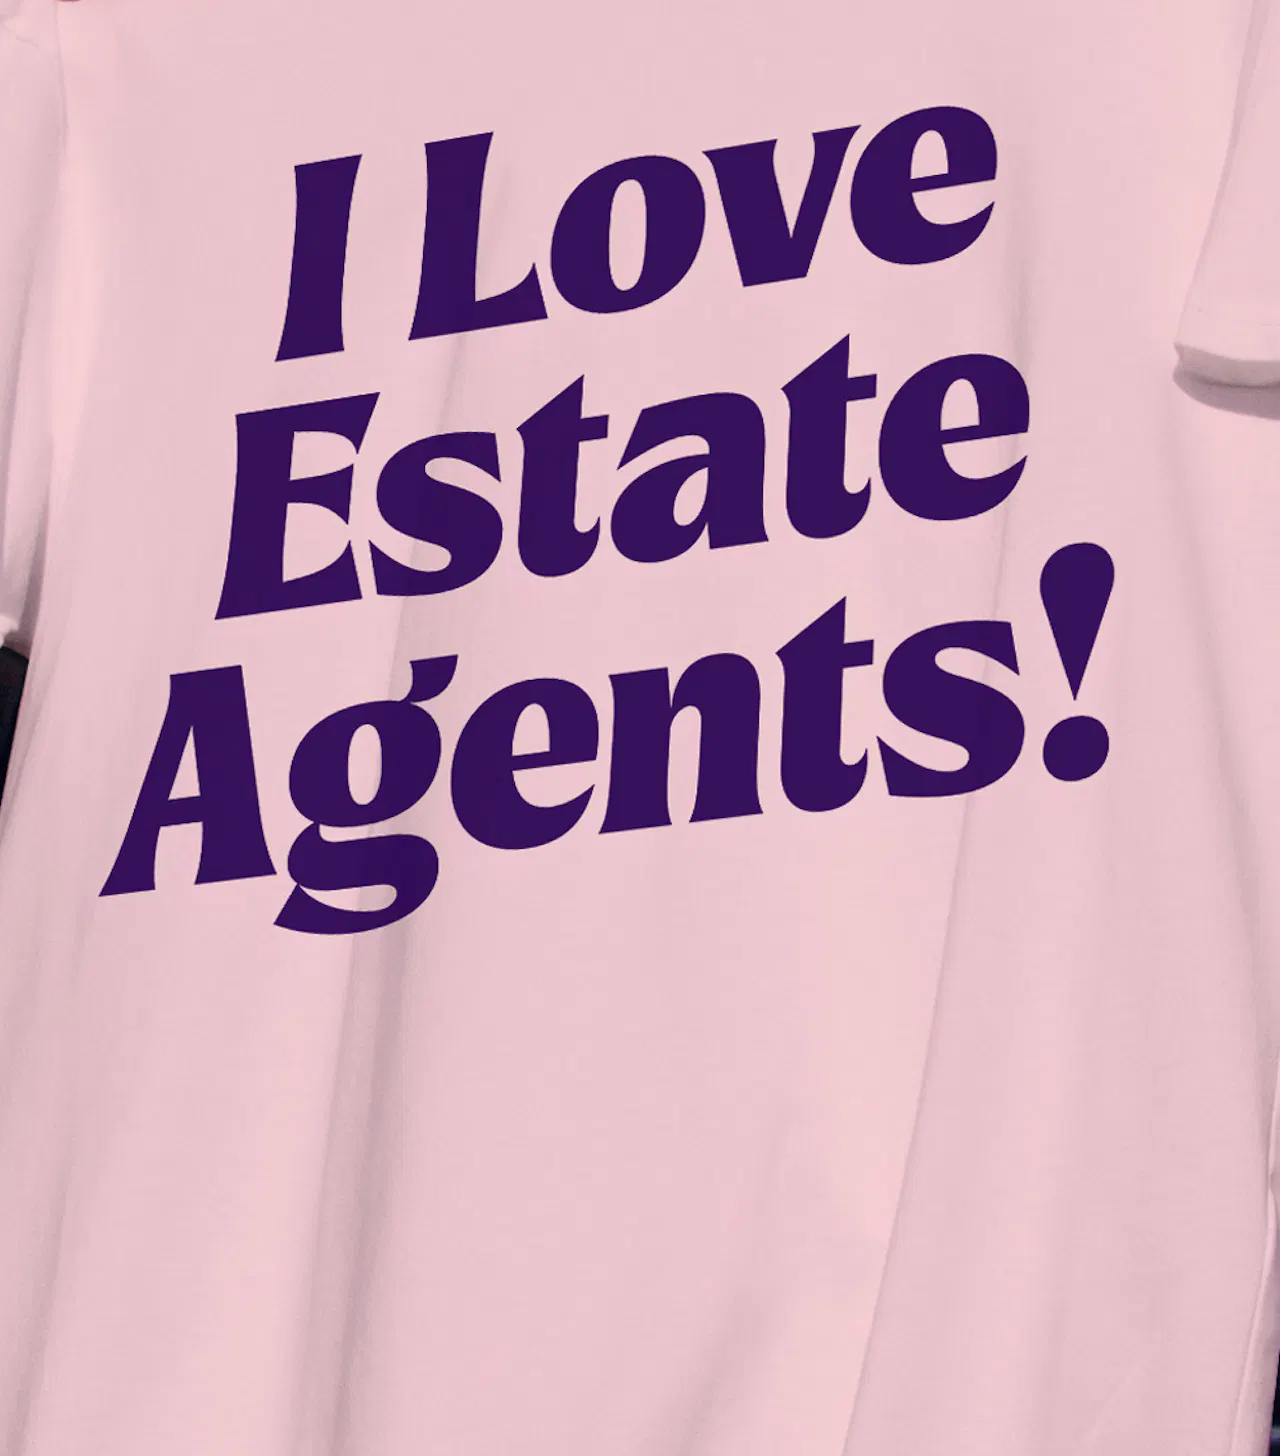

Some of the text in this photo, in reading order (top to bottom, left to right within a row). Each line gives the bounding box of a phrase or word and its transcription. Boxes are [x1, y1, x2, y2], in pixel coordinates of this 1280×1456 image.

[275, 106, 997, 361] I Love
[215, 334, 1029, 620] Estate
[99, 543, 1114, 934] Agents!
